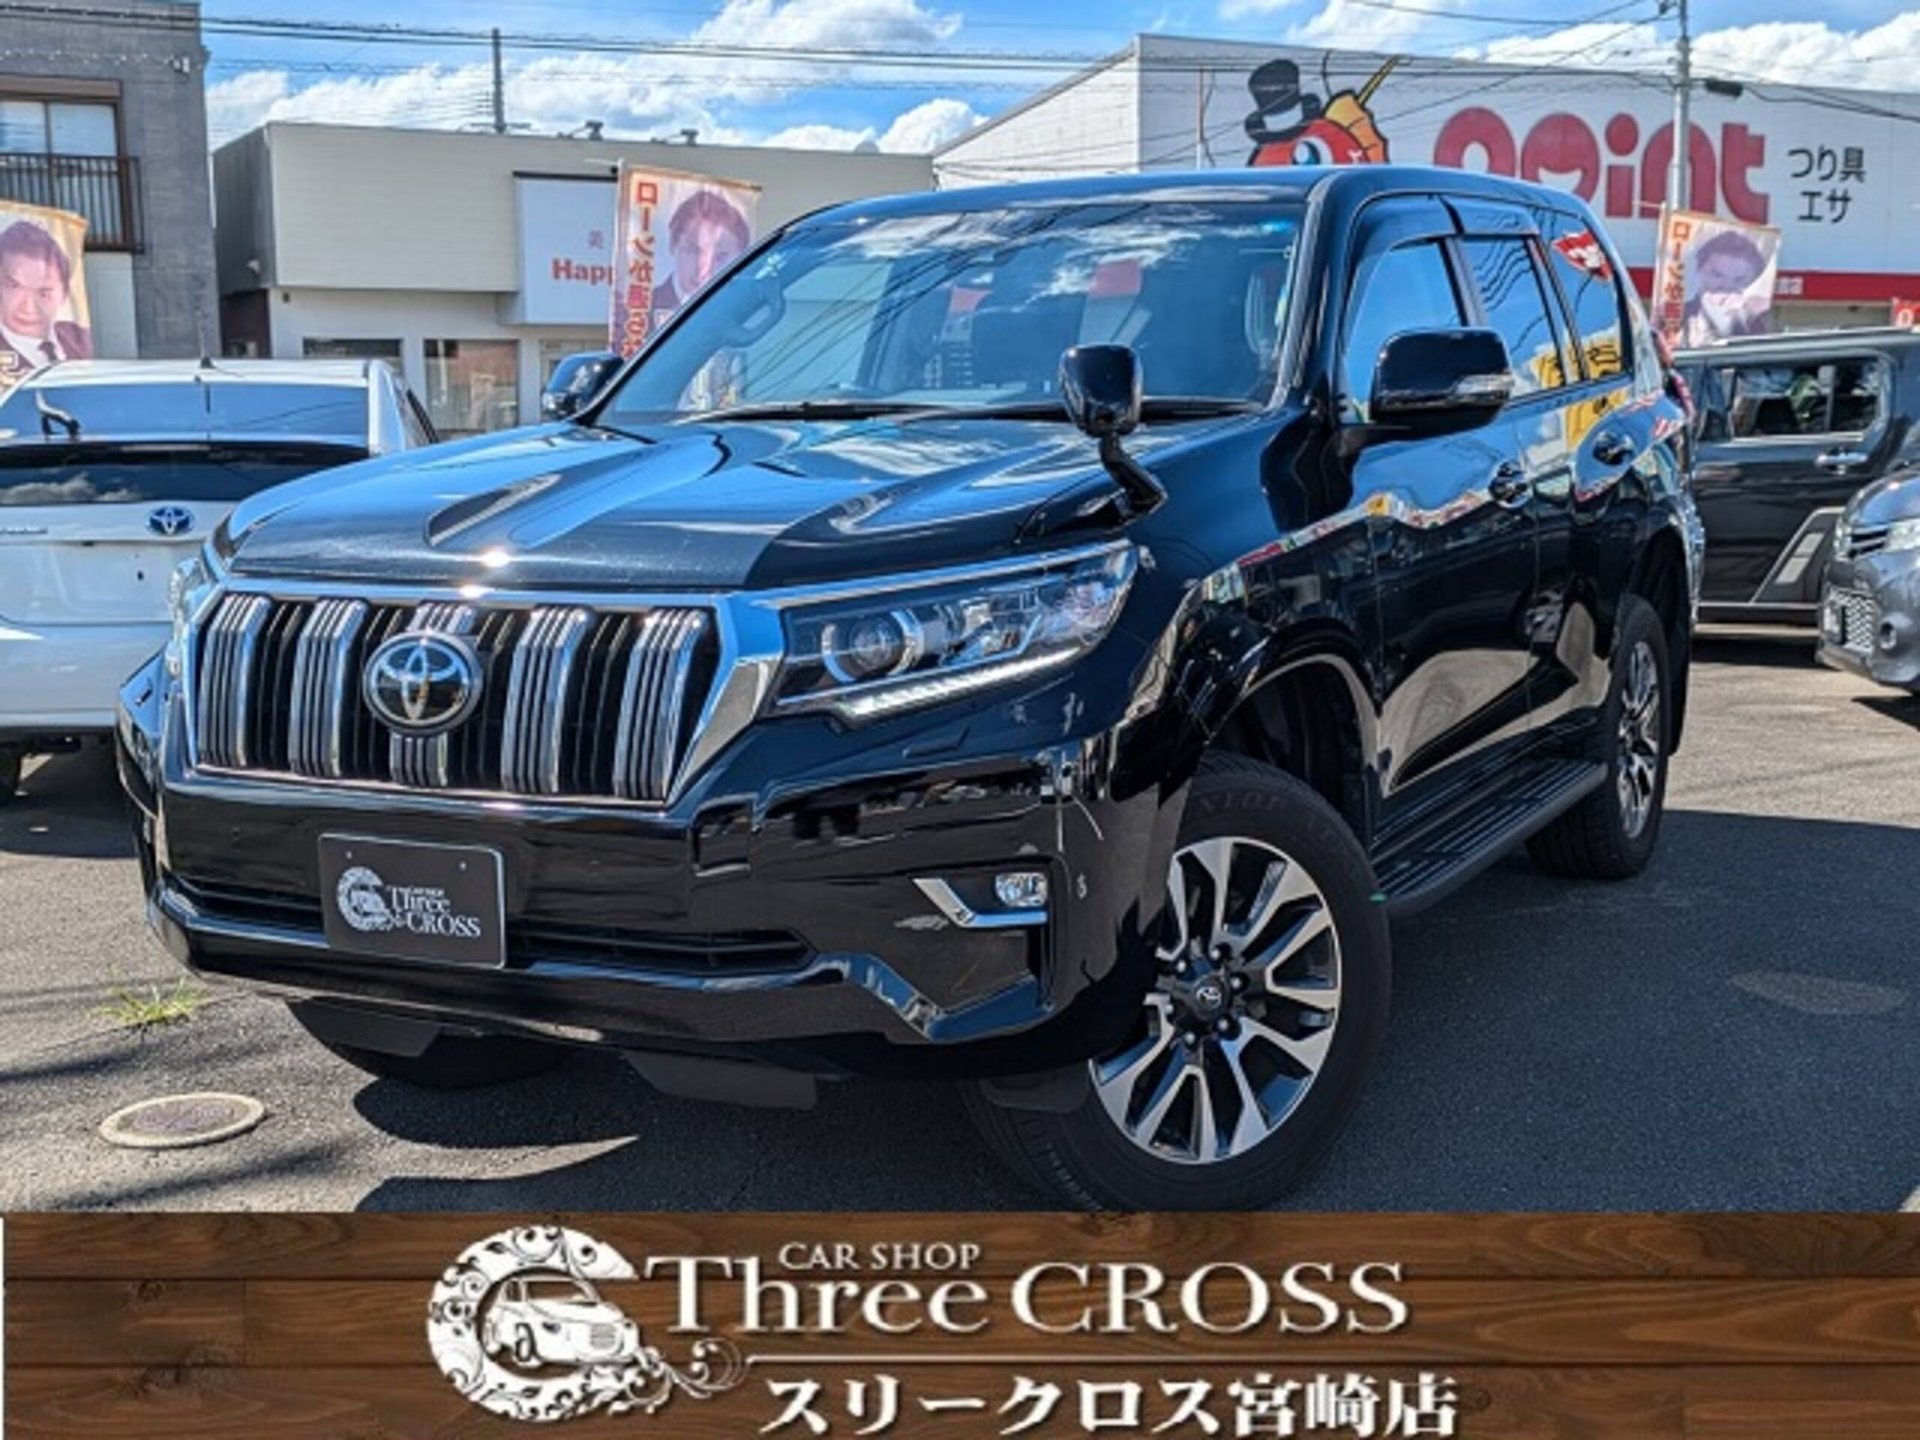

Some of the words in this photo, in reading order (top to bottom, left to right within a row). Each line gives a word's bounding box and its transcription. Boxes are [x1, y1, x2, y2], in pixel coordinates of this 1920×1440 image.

[1787, 146, 1866, 184] つり具
[1799, 188, 1852, 223] エサ
[387, 886, 451, 914] Three
[407, 911, 481, 938] CROSS
